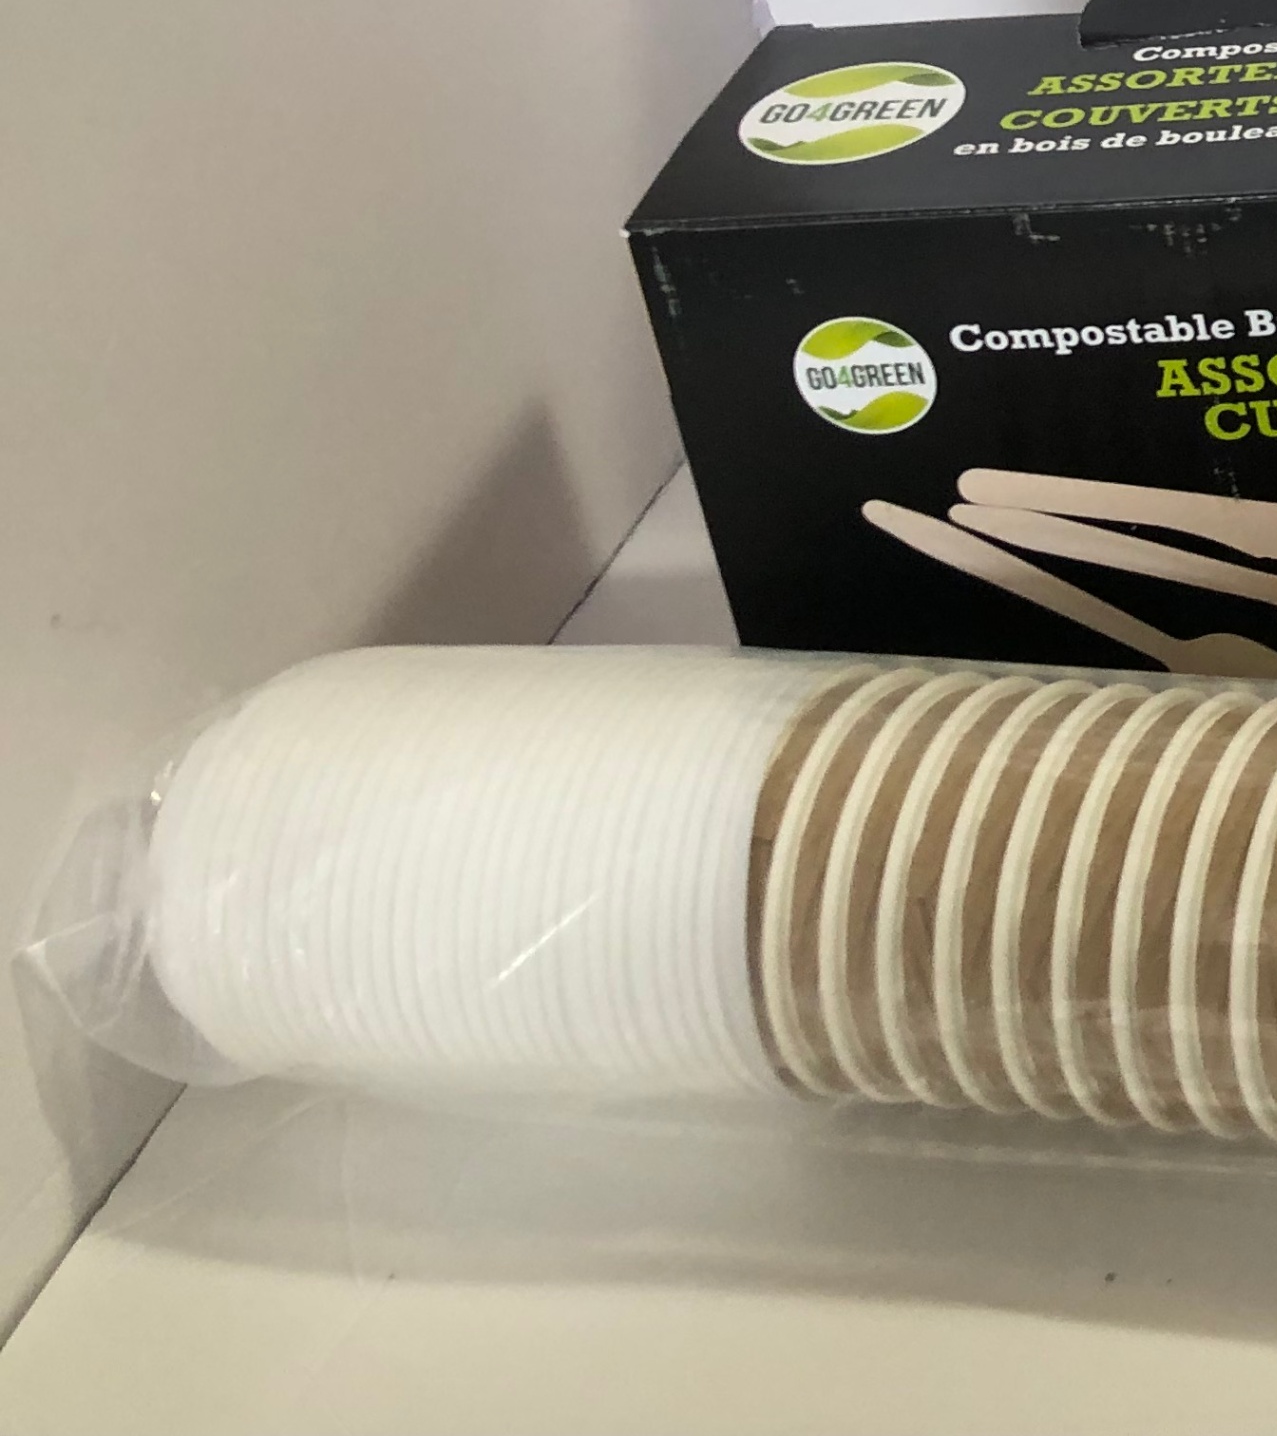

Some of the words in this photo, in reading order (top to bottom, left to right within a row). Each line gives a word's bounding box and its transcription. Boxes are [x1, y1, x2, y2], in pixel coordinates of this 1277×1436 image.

[760, 98, 948, 124] GO4GREEN
[953, 141, 1000, 156] en
[1007, 135, 1092, 154] bois
[1099, 132, 1148, 150] de
[950, 313, 1236, 355] Compostable
[806, 361, 926, 391] GO4GREEN
